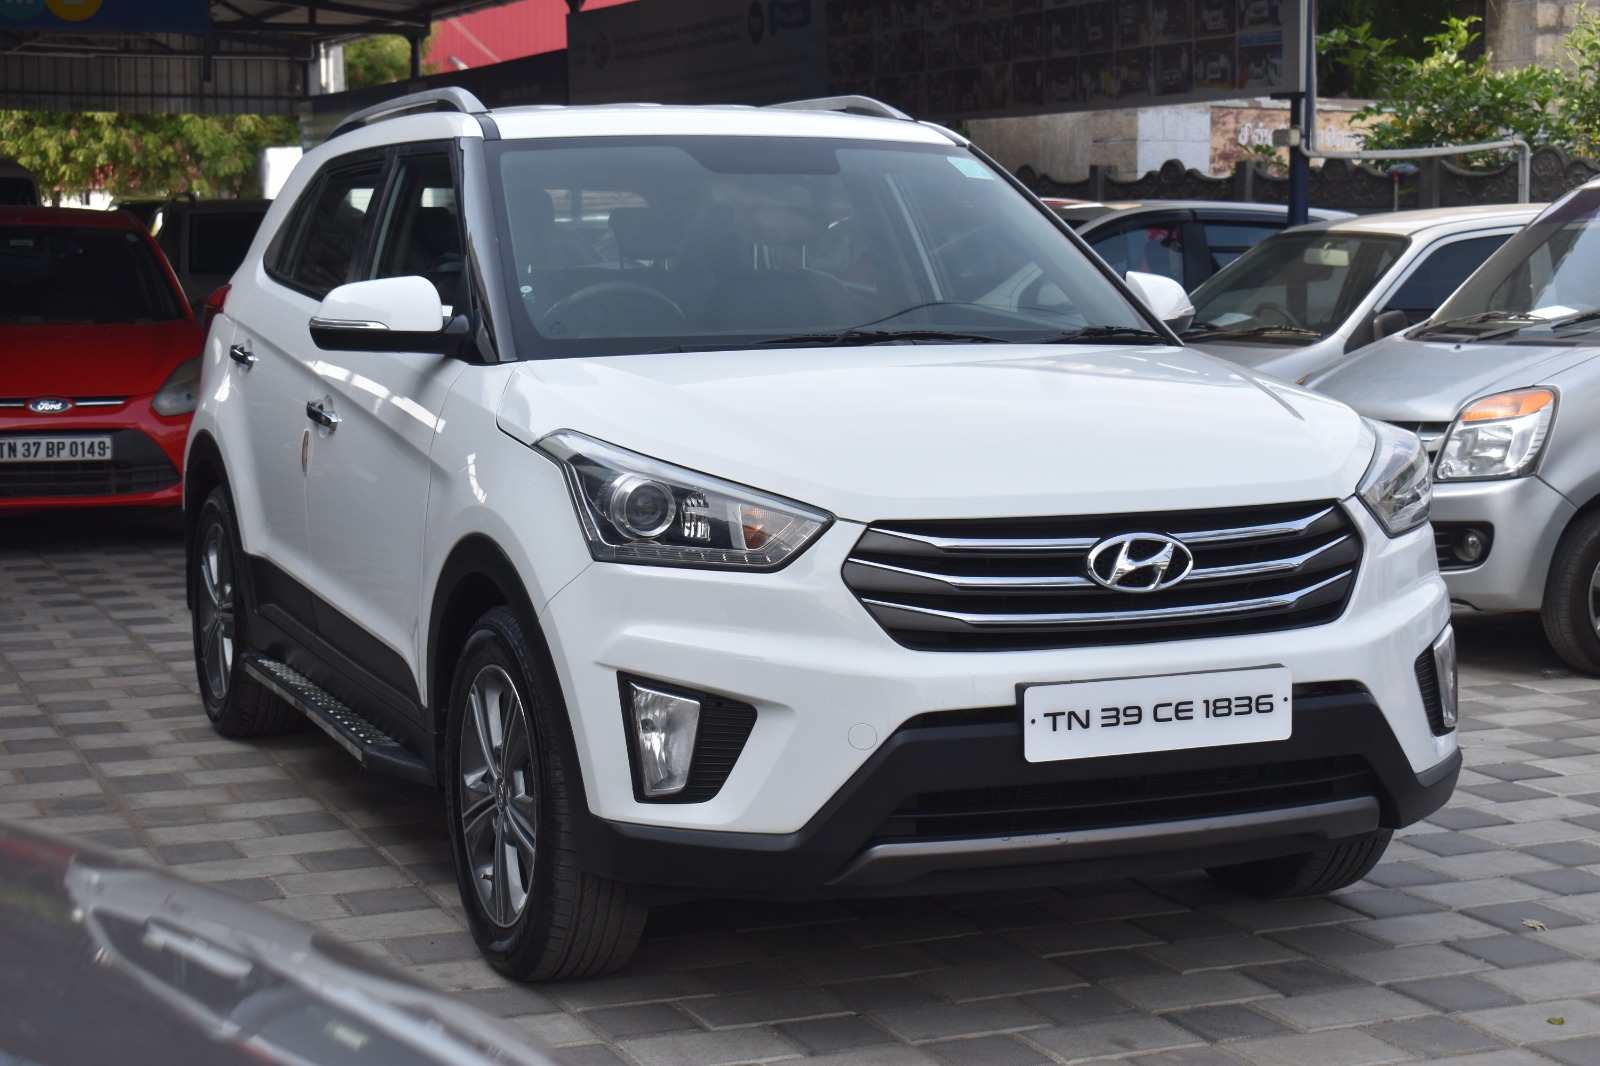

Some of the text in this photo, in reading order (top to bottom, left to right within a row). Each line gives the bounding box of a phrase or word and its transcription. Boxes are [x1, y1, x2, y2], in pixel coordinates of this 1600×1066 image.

[37, 401, 62, 411] Ford
[0, 441, 106, 458] TN 37 BP 0149
[1043, 694, 1274, 732] TN 39 CE 1836
